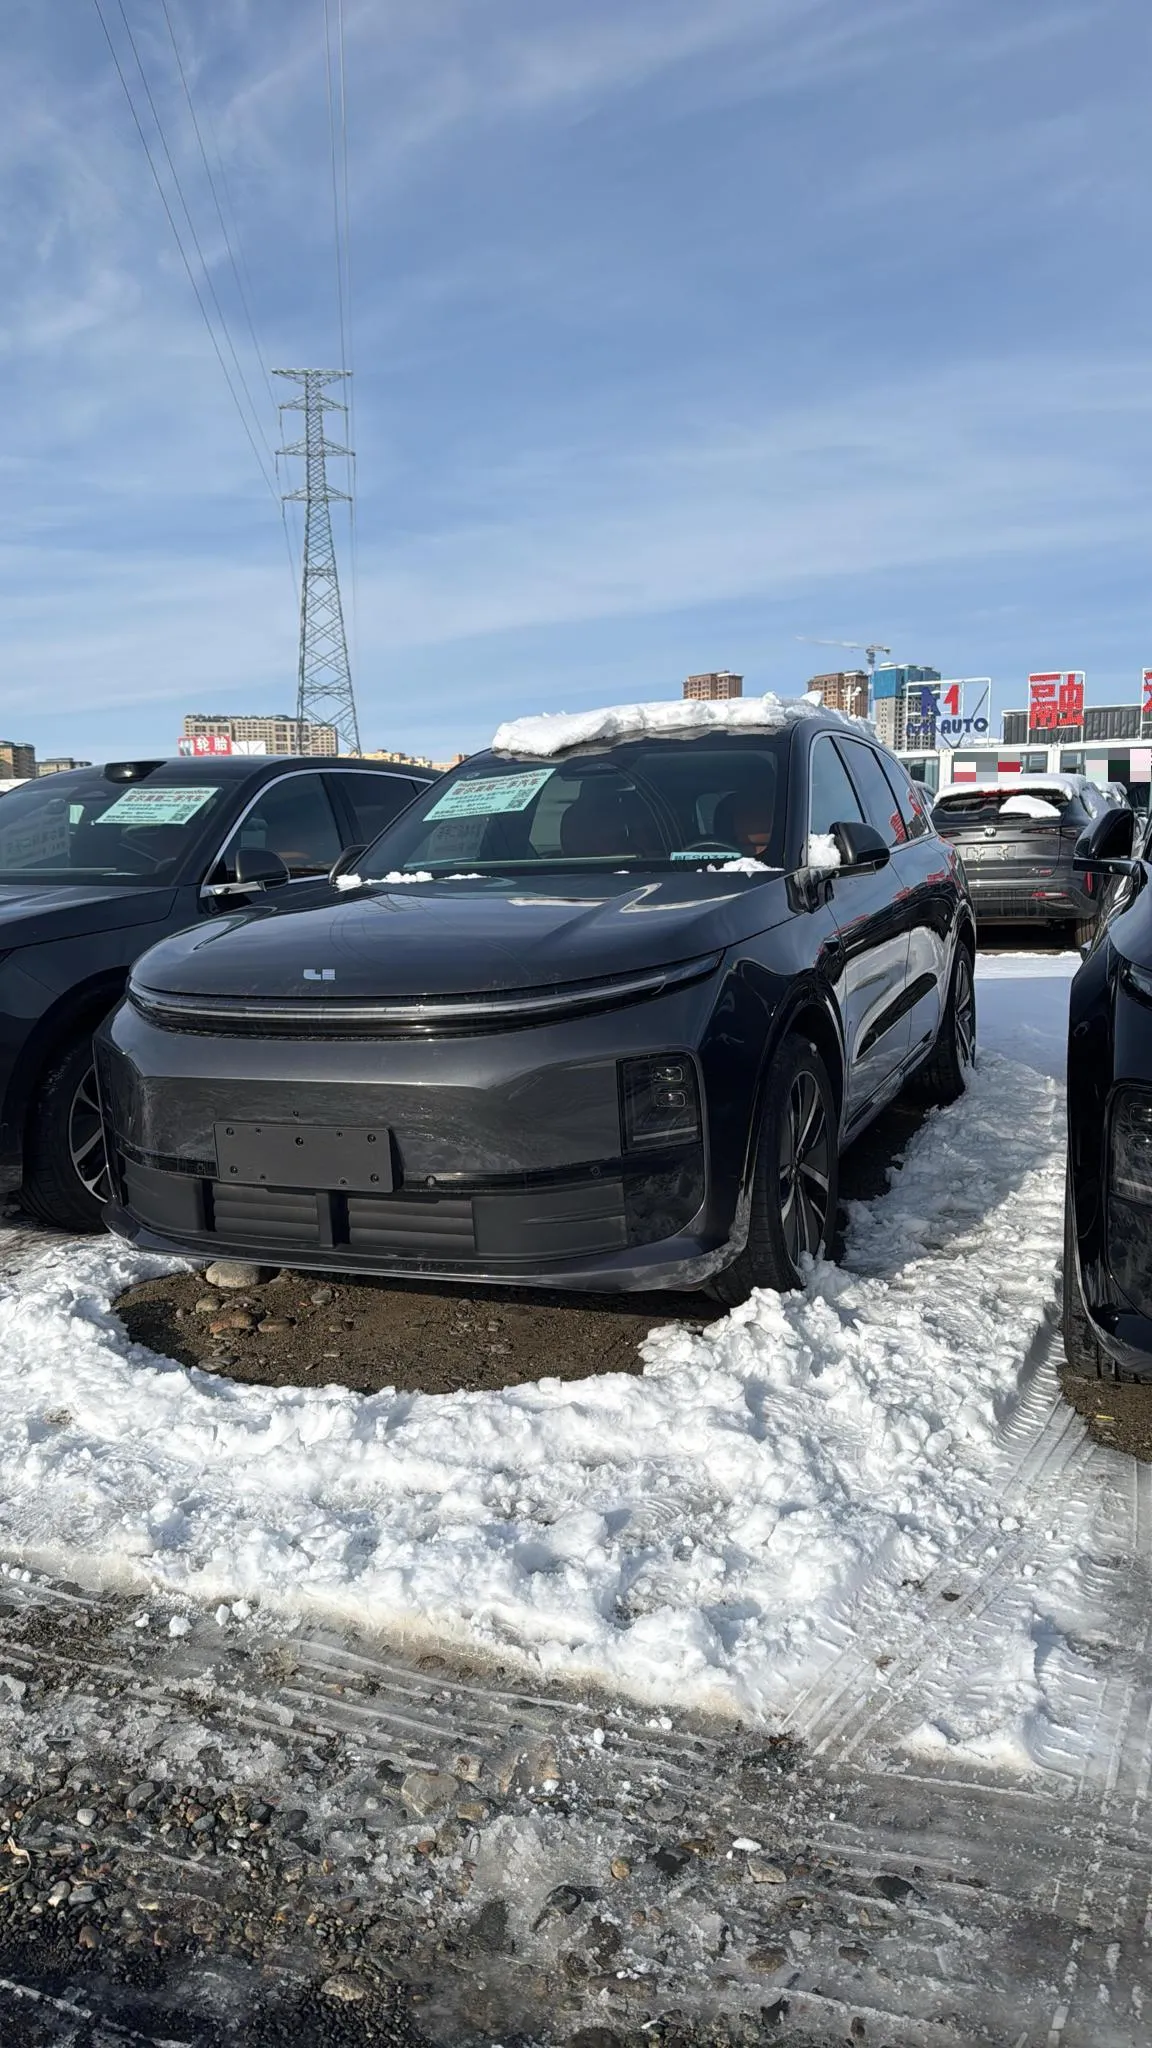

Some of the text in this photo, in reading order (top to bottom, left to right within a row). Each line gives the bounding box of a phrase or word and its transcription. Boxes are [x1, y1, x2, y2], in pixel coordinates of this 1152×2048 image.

[1029, 673, 1084, 731] 融
[941, 718, 989, 734] AUTO
[196, 736, 228, 752] 轮胎
